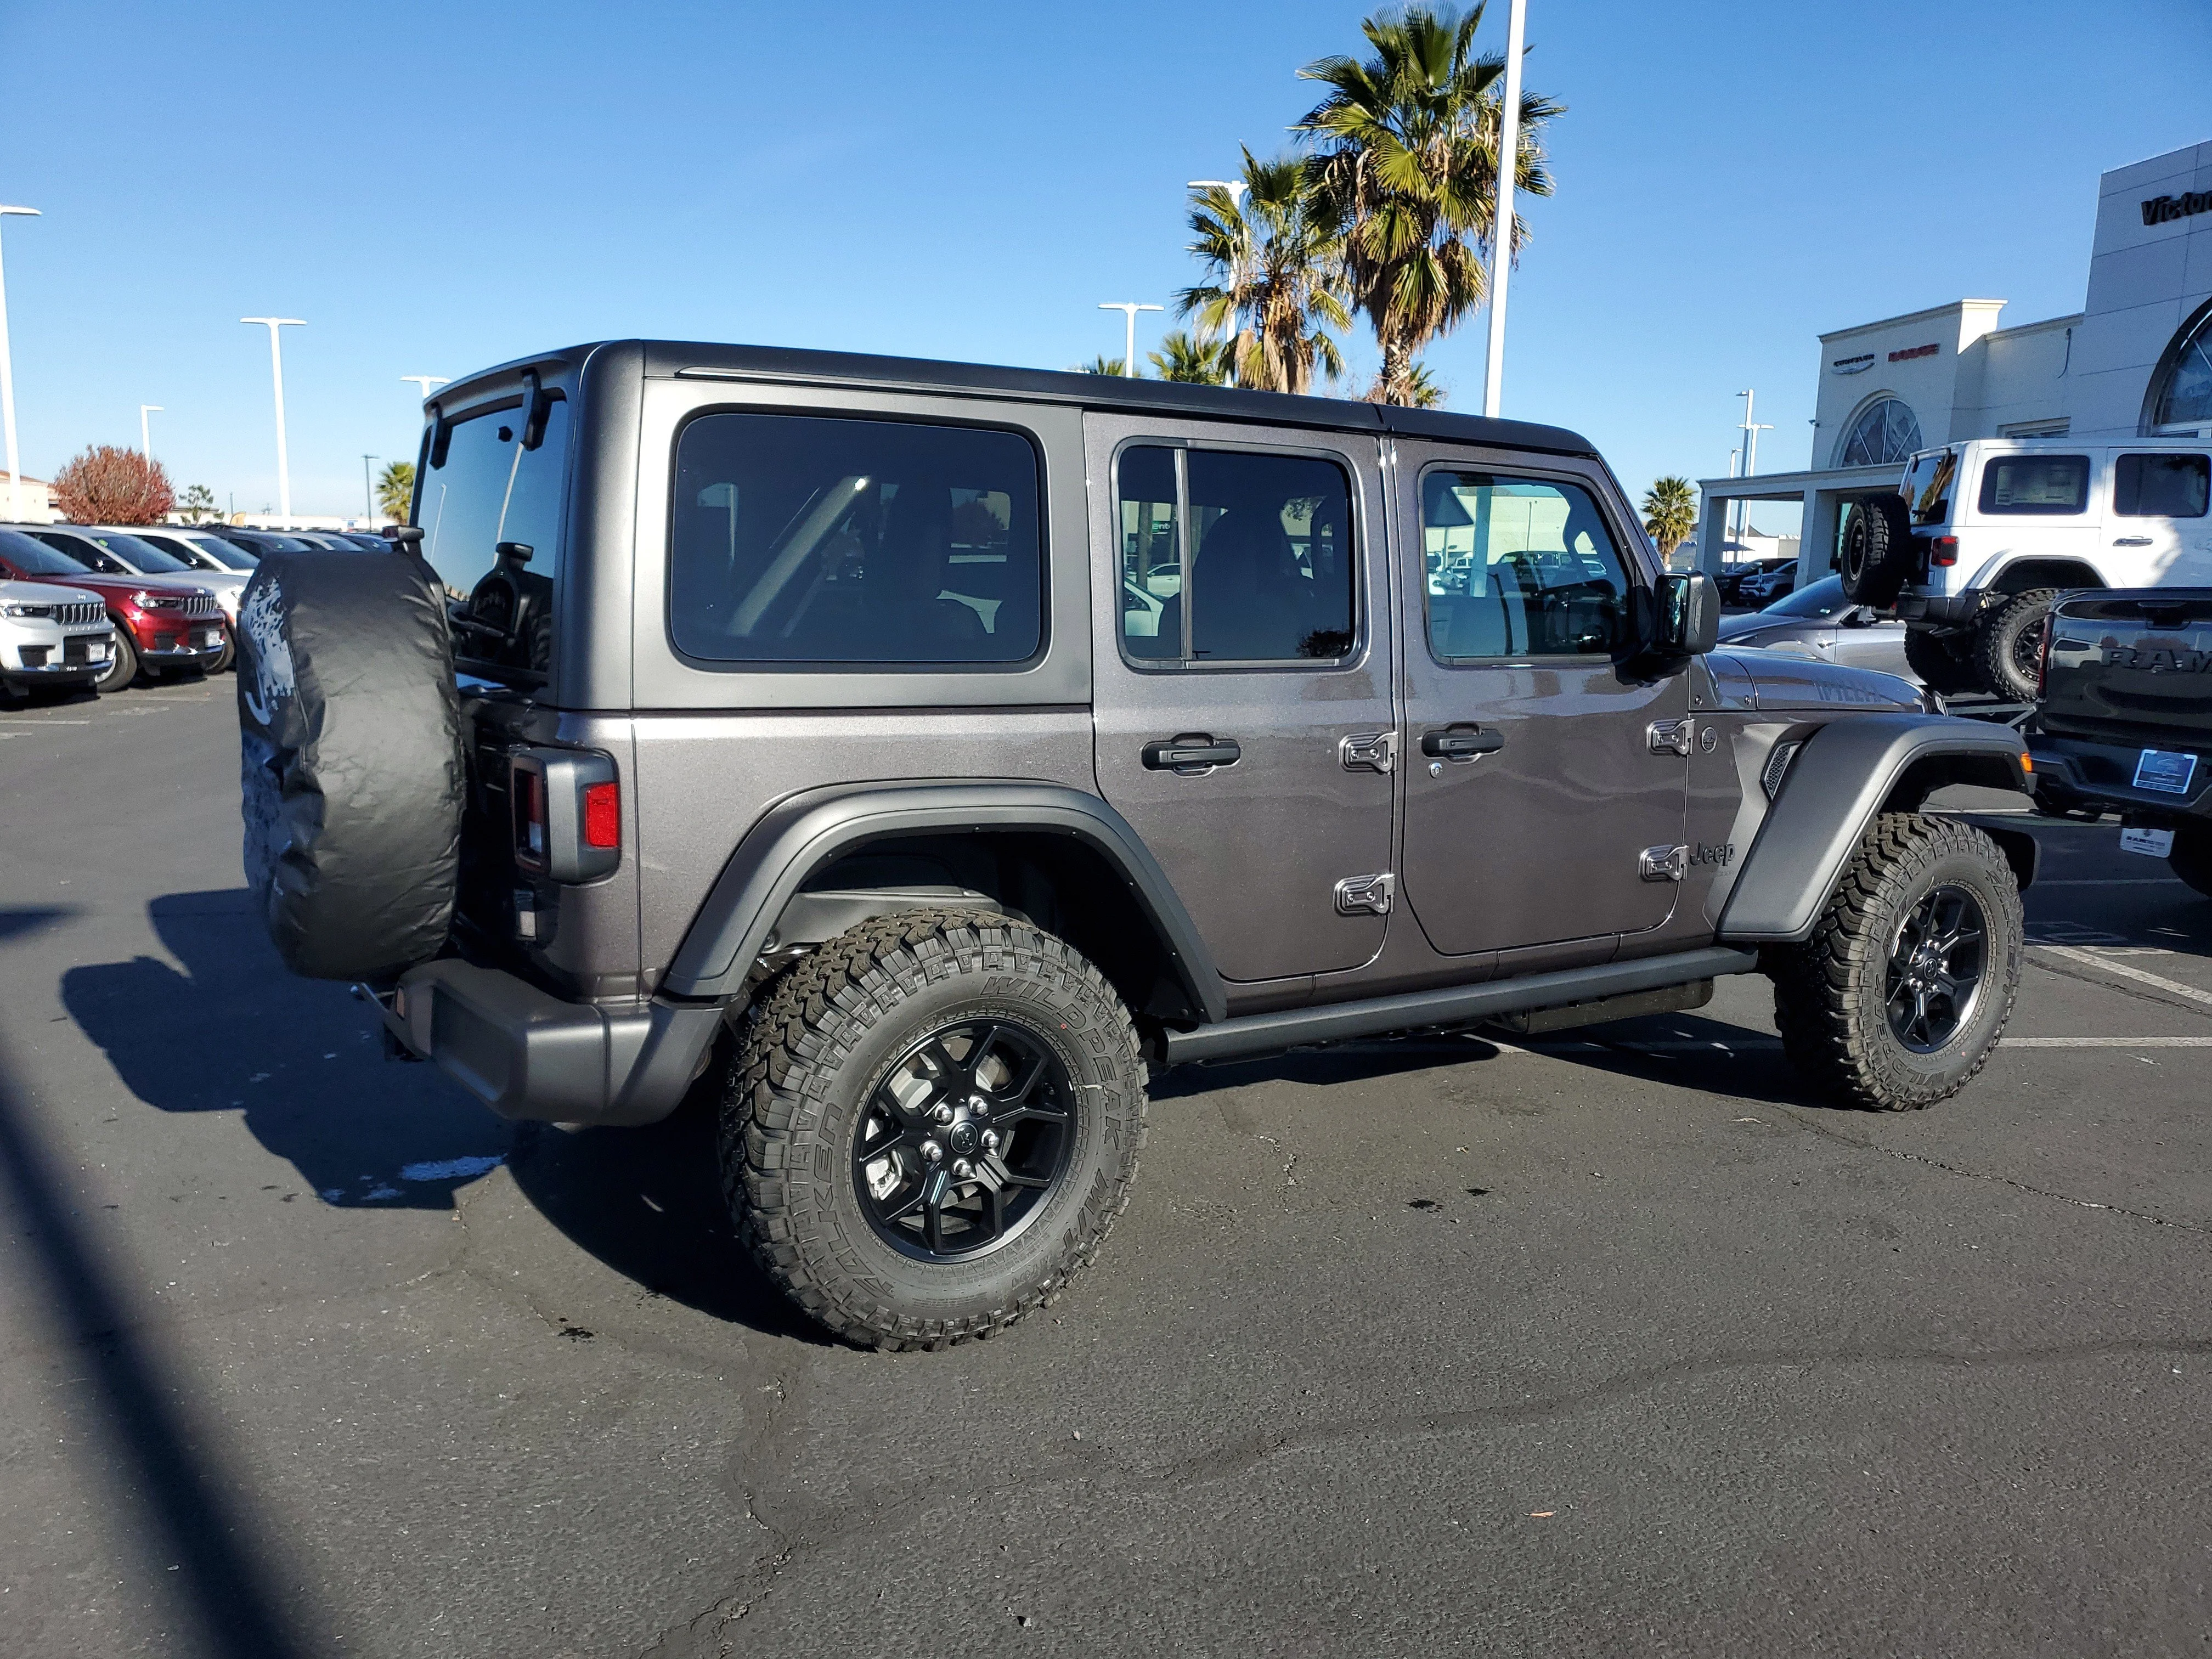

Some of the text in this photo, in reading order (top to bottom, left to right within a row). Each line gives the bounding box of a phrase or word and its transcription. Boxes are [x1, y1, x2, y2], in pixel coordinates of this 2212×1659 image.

[2101, 647, 2212, 673] RAM
[1690, 842, 1736, 866] Jeep
[980, 976, 1121, 1150] WILDPEAK
[1063, 1167, 1109, 1257] M/T
[814, 1102, 894, 1299] FALKEN
